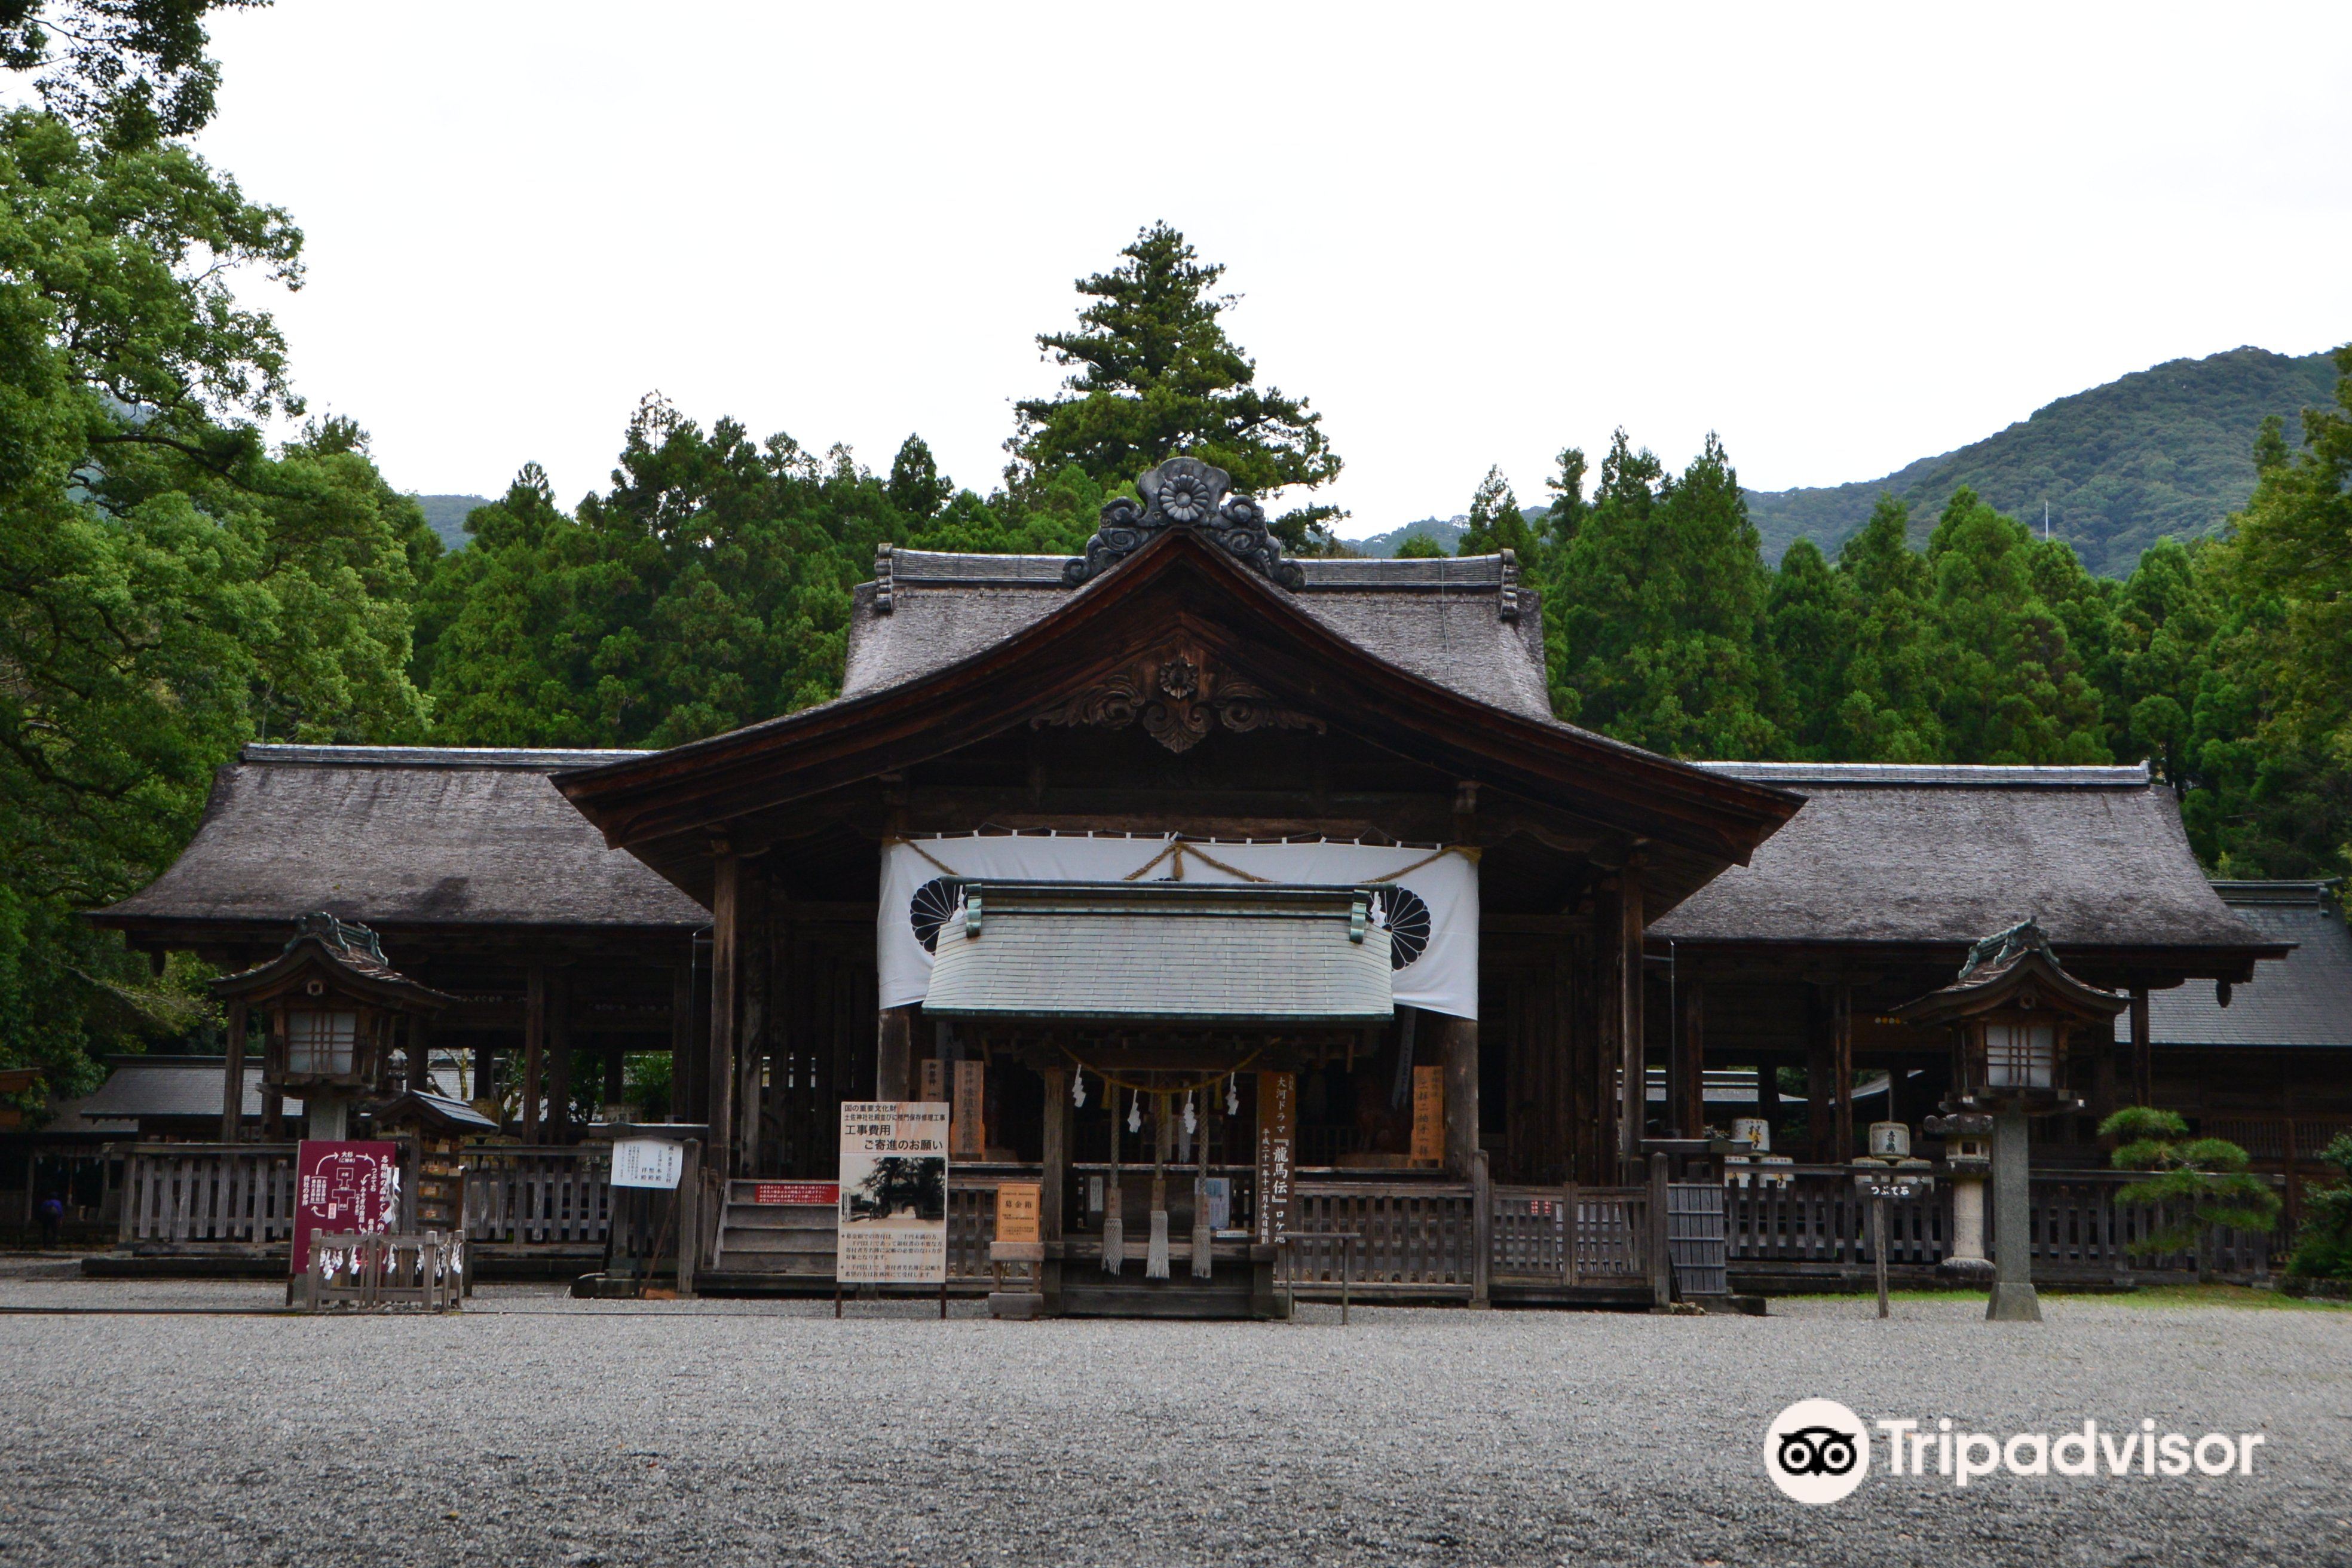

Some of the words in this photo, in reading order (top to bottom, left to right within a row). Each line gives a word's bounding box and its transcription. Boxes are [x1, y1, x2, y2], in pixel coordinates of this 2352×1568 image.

[844, 1125, 891, 1135] 工事費用
[864, 1140, 943, 1150] ご寄進のお願い
[1261, 1128, 1270, 1245] 平成二十一年十二月十九日撮影
[1870, 1186, 1910, 1196] つぶて石
